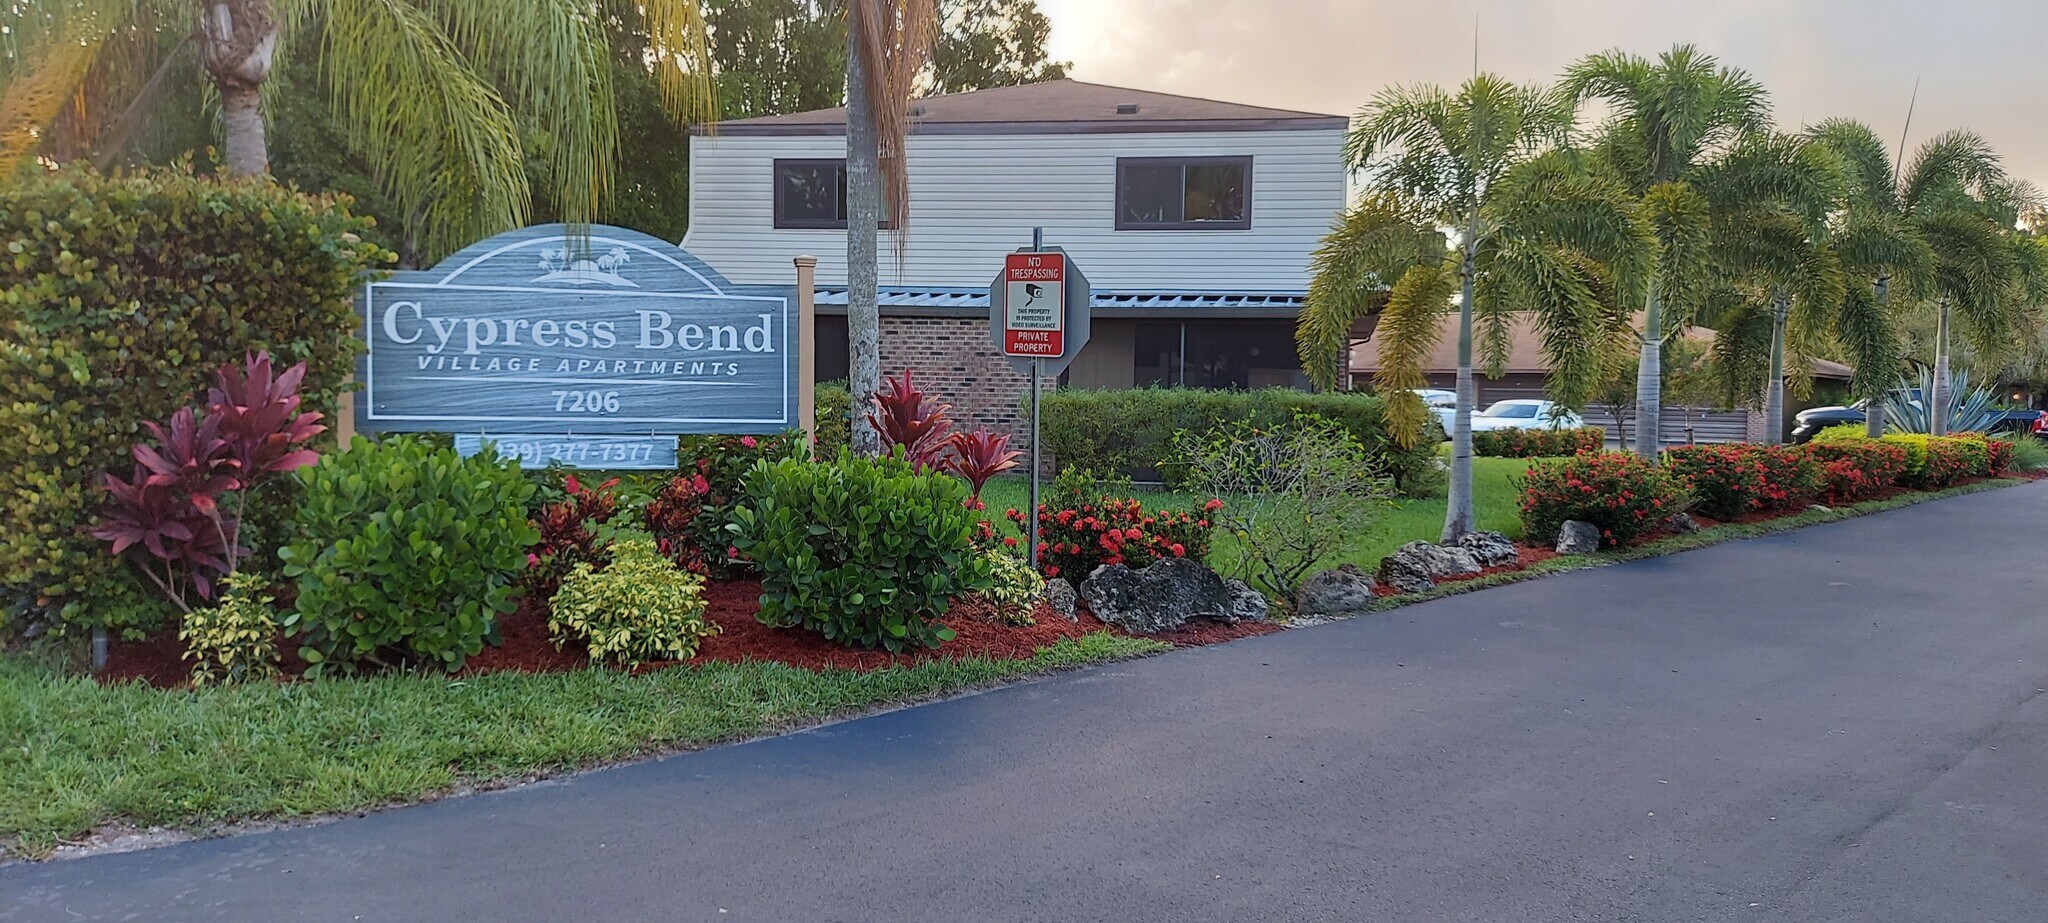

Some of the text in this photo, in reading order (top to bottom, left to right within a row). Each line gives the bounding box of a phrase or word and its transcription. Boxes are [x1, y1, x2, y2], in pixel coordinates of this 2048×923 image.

[1028, 257, 1041, 267] NO
[1011, 268, 1059, 279] TRESPASSING
[382, 301, 775, 355] Cypress Bend
[1018, 331, 1049, 342] PRIVATE
[1013, 342, 1053, 353] PROPERTY
[417, 355, 740, 376] VILLAGE APARTMENTS
[551, 391, 621, 413] 7206
[550, 443, 654, 461] 277-7377
